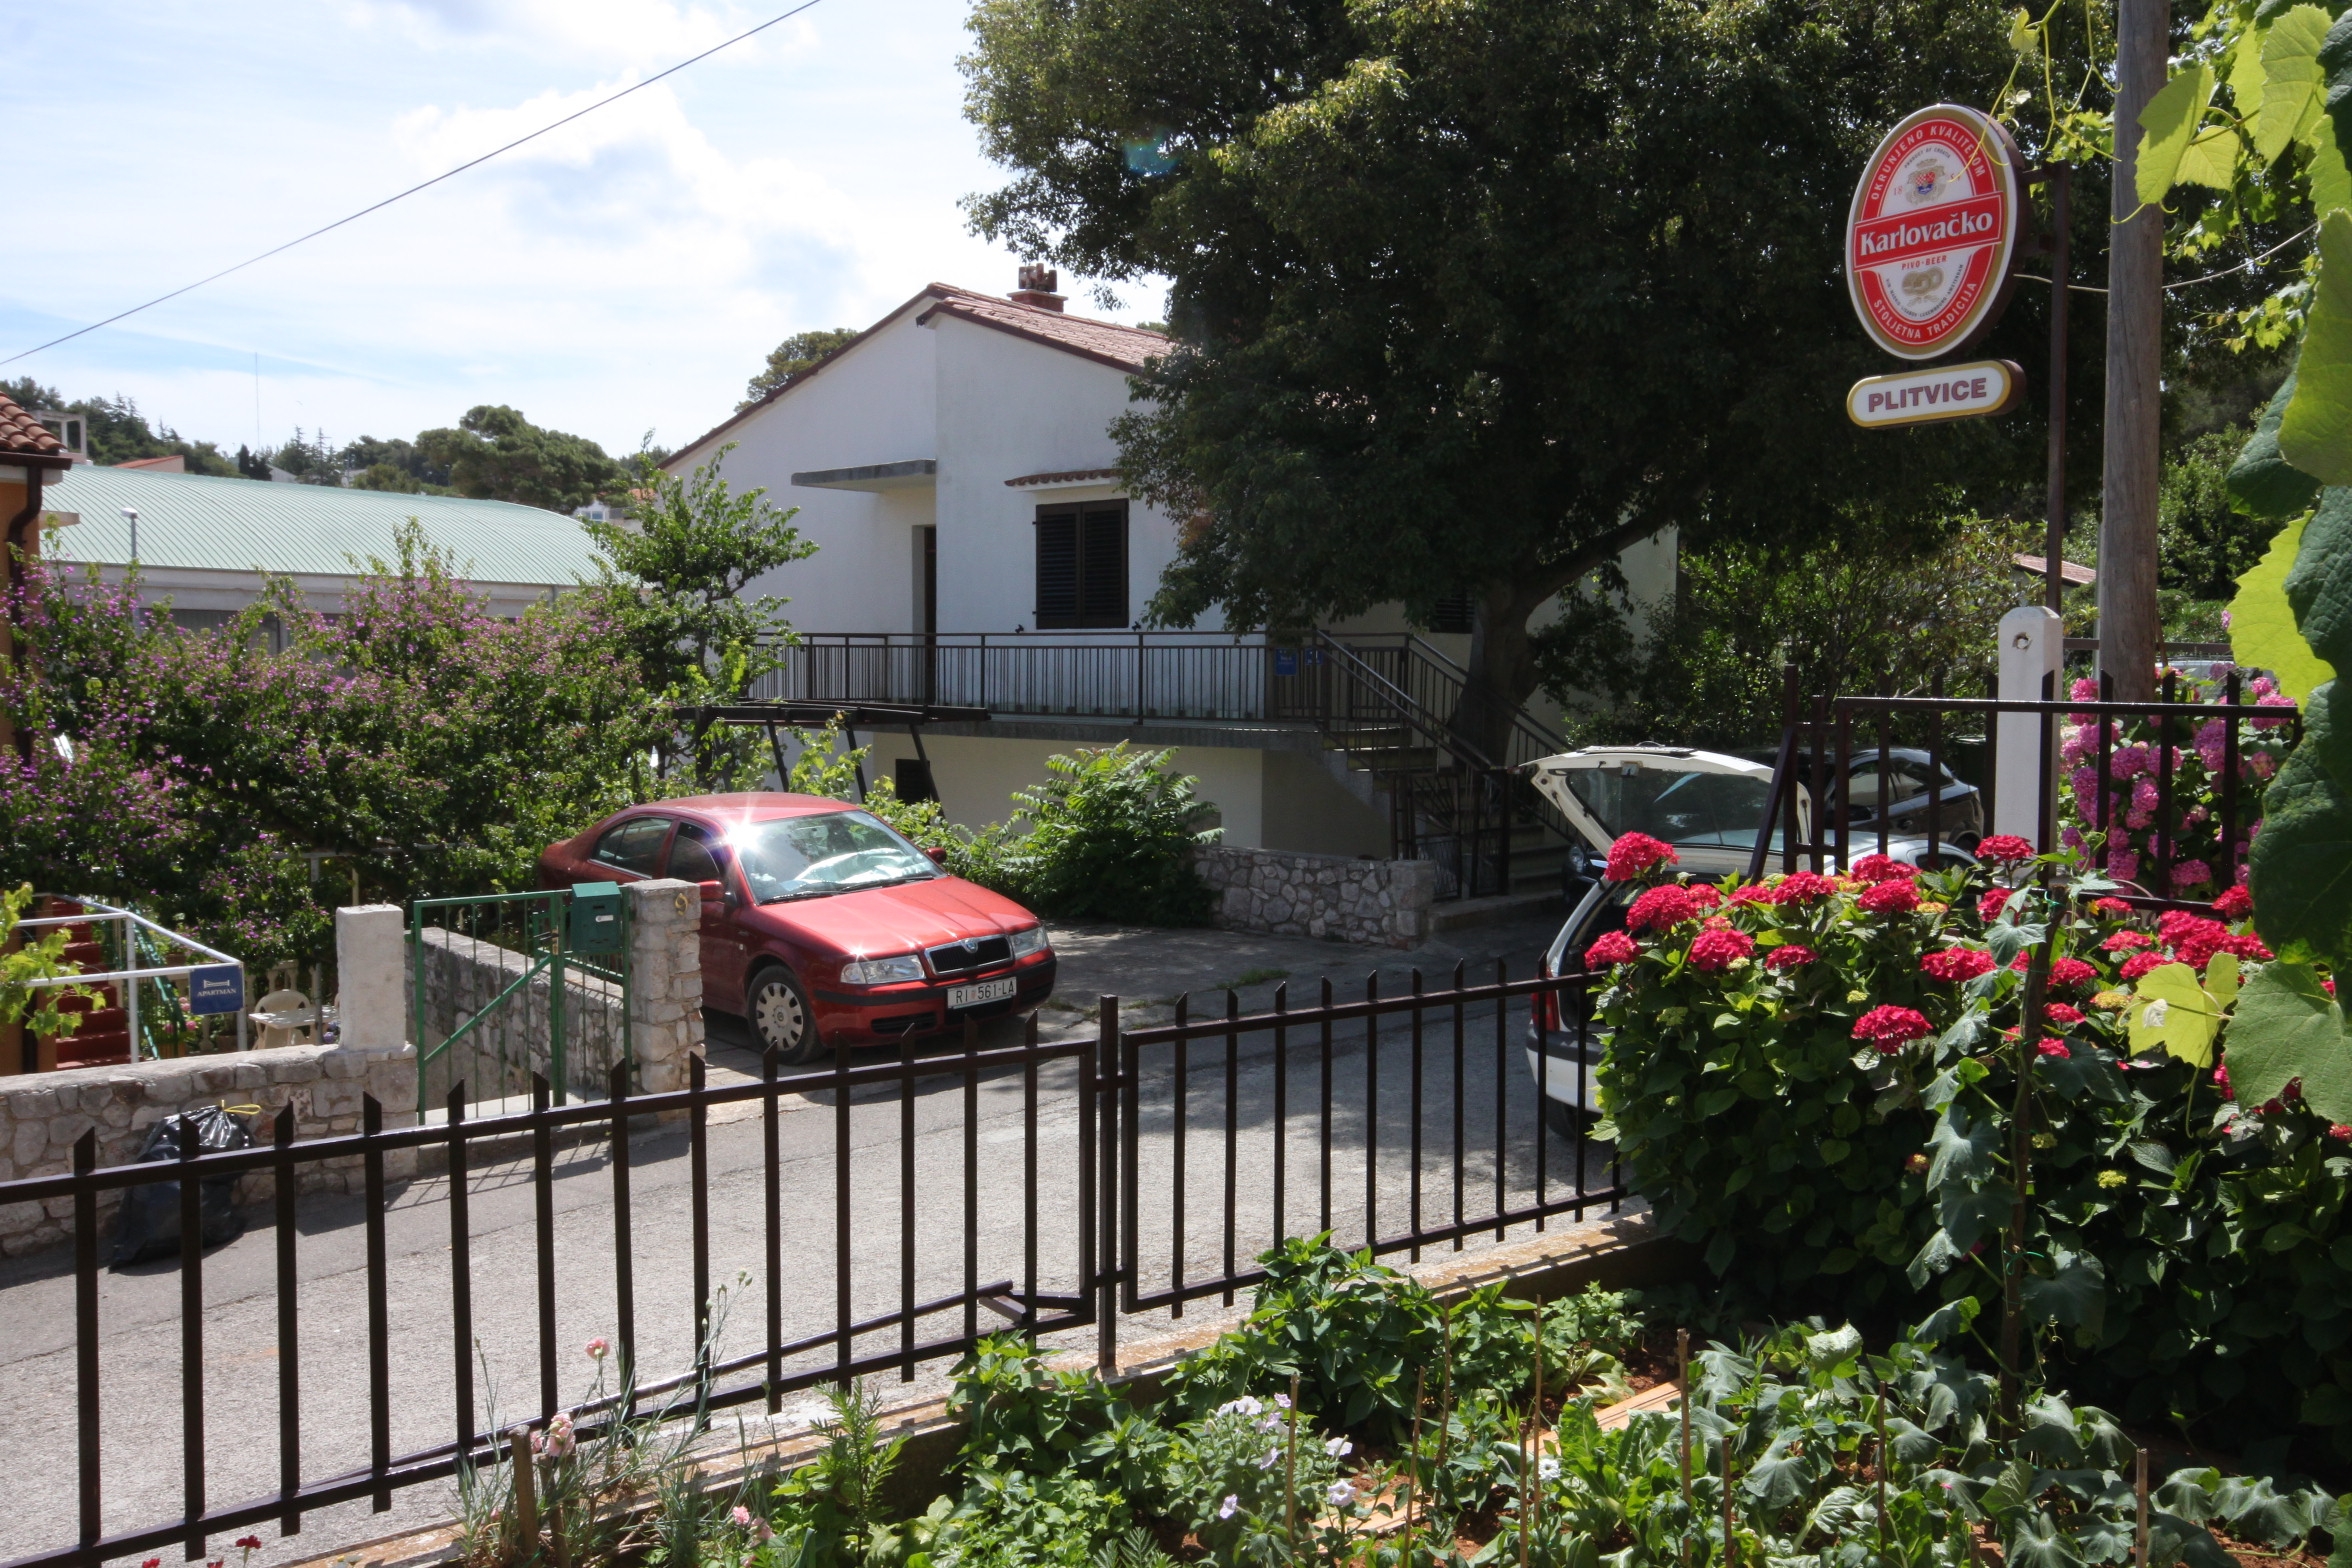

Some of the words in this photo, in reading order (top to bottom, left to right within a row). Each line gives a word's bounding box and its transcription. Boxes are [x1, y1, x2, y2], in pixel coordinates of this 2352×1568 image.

[1871, 130, 1924, 200] OKRUNJENO
[1860, 210, 1993, 256] Karlovačko
[1873, 299, 1922, 340] STOLJETNA
[1926, 281, 1977, 336] TRADICIJA
[1868, 377, 1987, 413] PLITVICE
[675, 892, 688, 916] 9
[197, 989, 237, 997] APARTMAN
[955, 990, 968, 1004] RI
